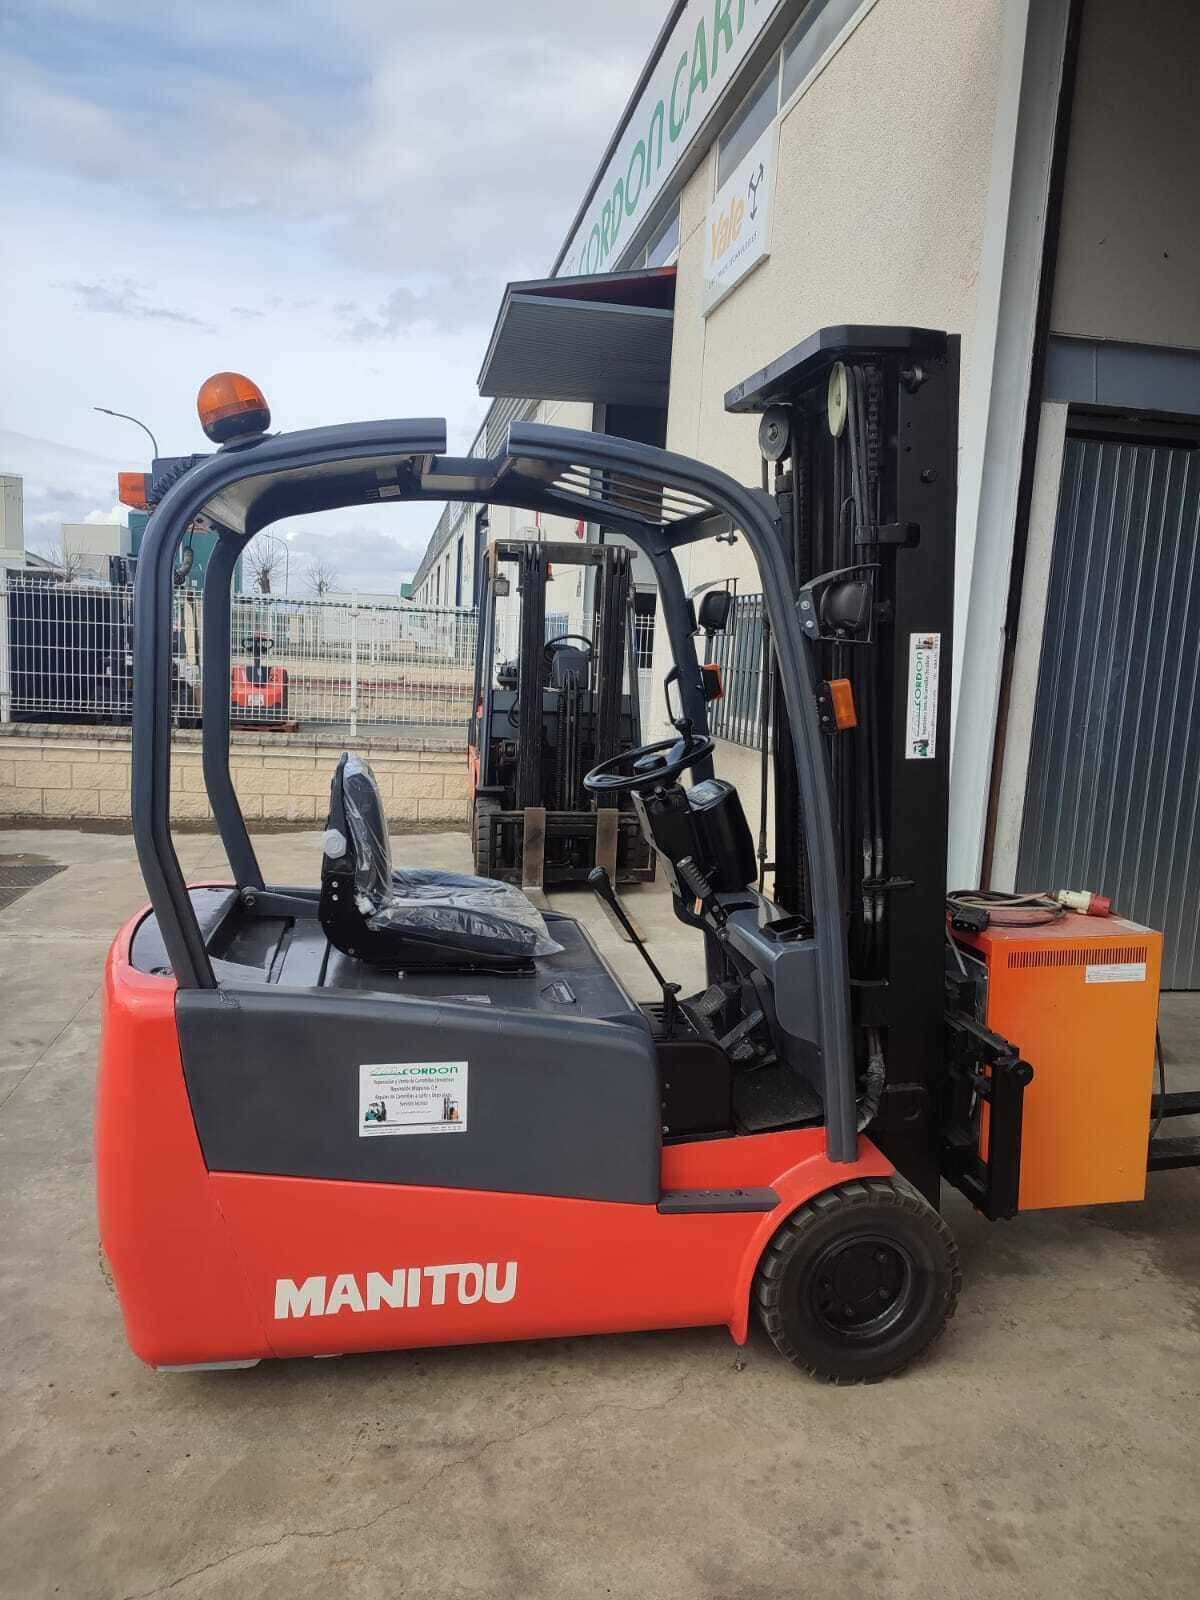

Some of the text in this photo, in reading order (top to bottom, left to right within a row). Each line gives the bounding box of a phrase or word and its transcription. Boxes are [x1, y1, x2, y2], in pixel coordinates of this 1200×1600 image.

[711, 196, 747, 263] Yale
[914, 651, 923, 706] CORDON
[402, 1066, 458, 1075] CORDON
[273, 1261, 518, 1320] MANITOU
